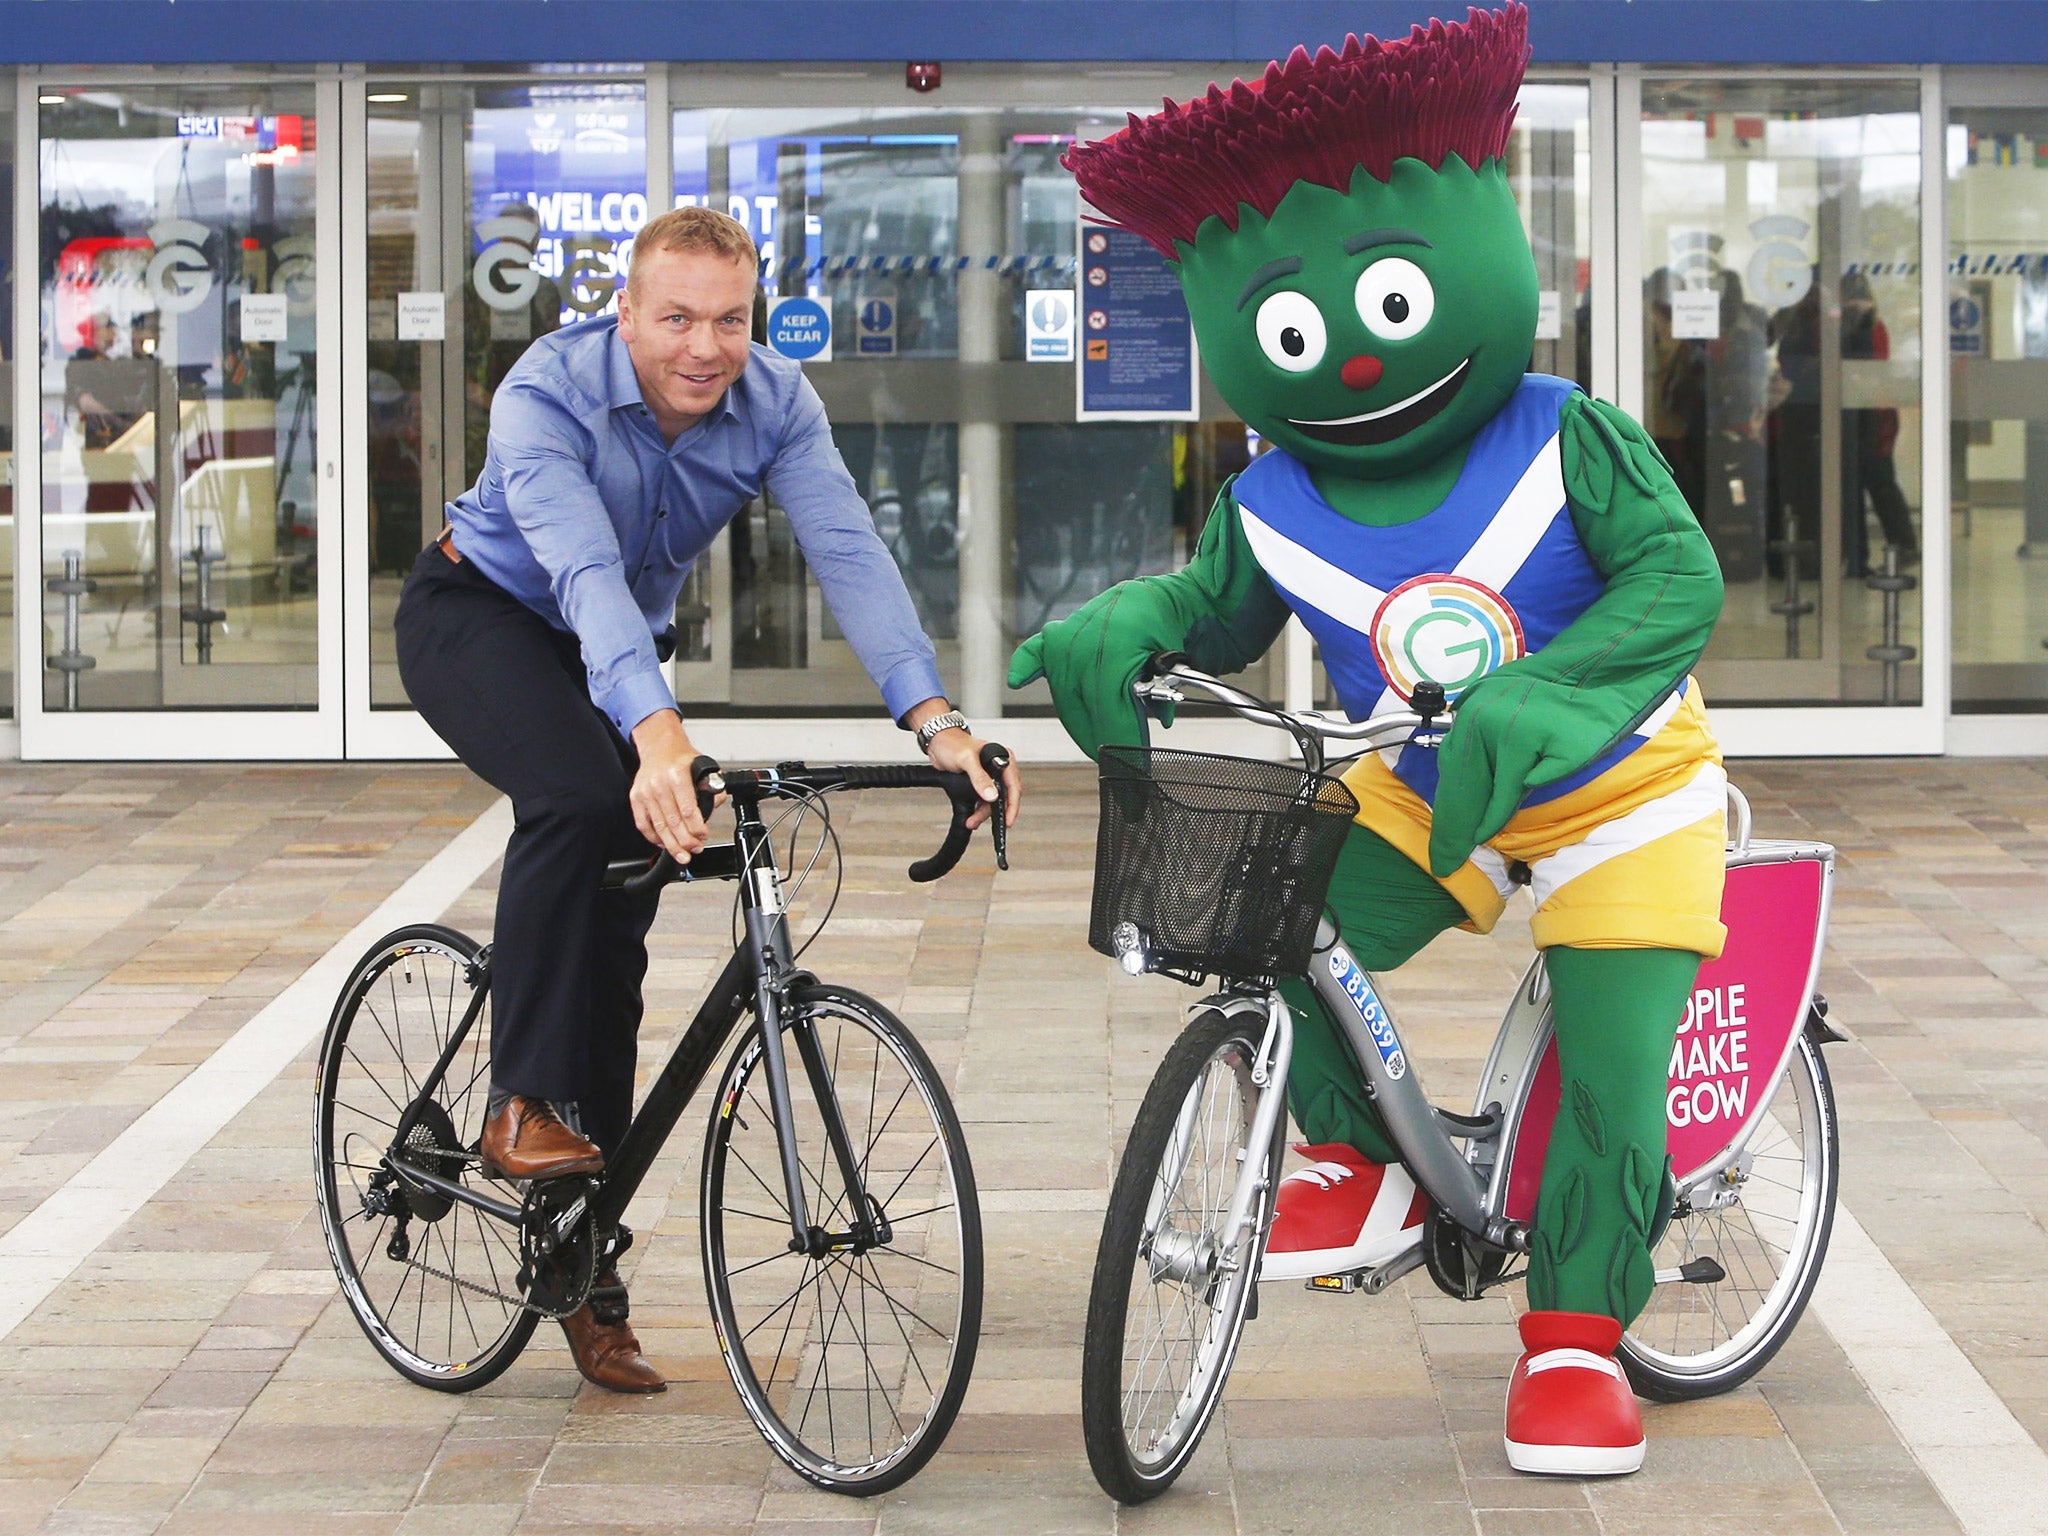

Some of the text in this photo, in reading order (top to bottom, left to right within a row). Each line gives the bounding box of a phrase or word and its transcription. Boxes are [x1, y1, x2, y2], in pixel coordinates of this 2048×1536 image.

[776, 331, 822, 343] CLEAR
[782, 315, 817, 327] KEEP
[1346, 971, 1395, 1048] 81639
[1676, 983, 1747, 1035] OPLE
[1666, 1075, 1749, 1128] GOW
